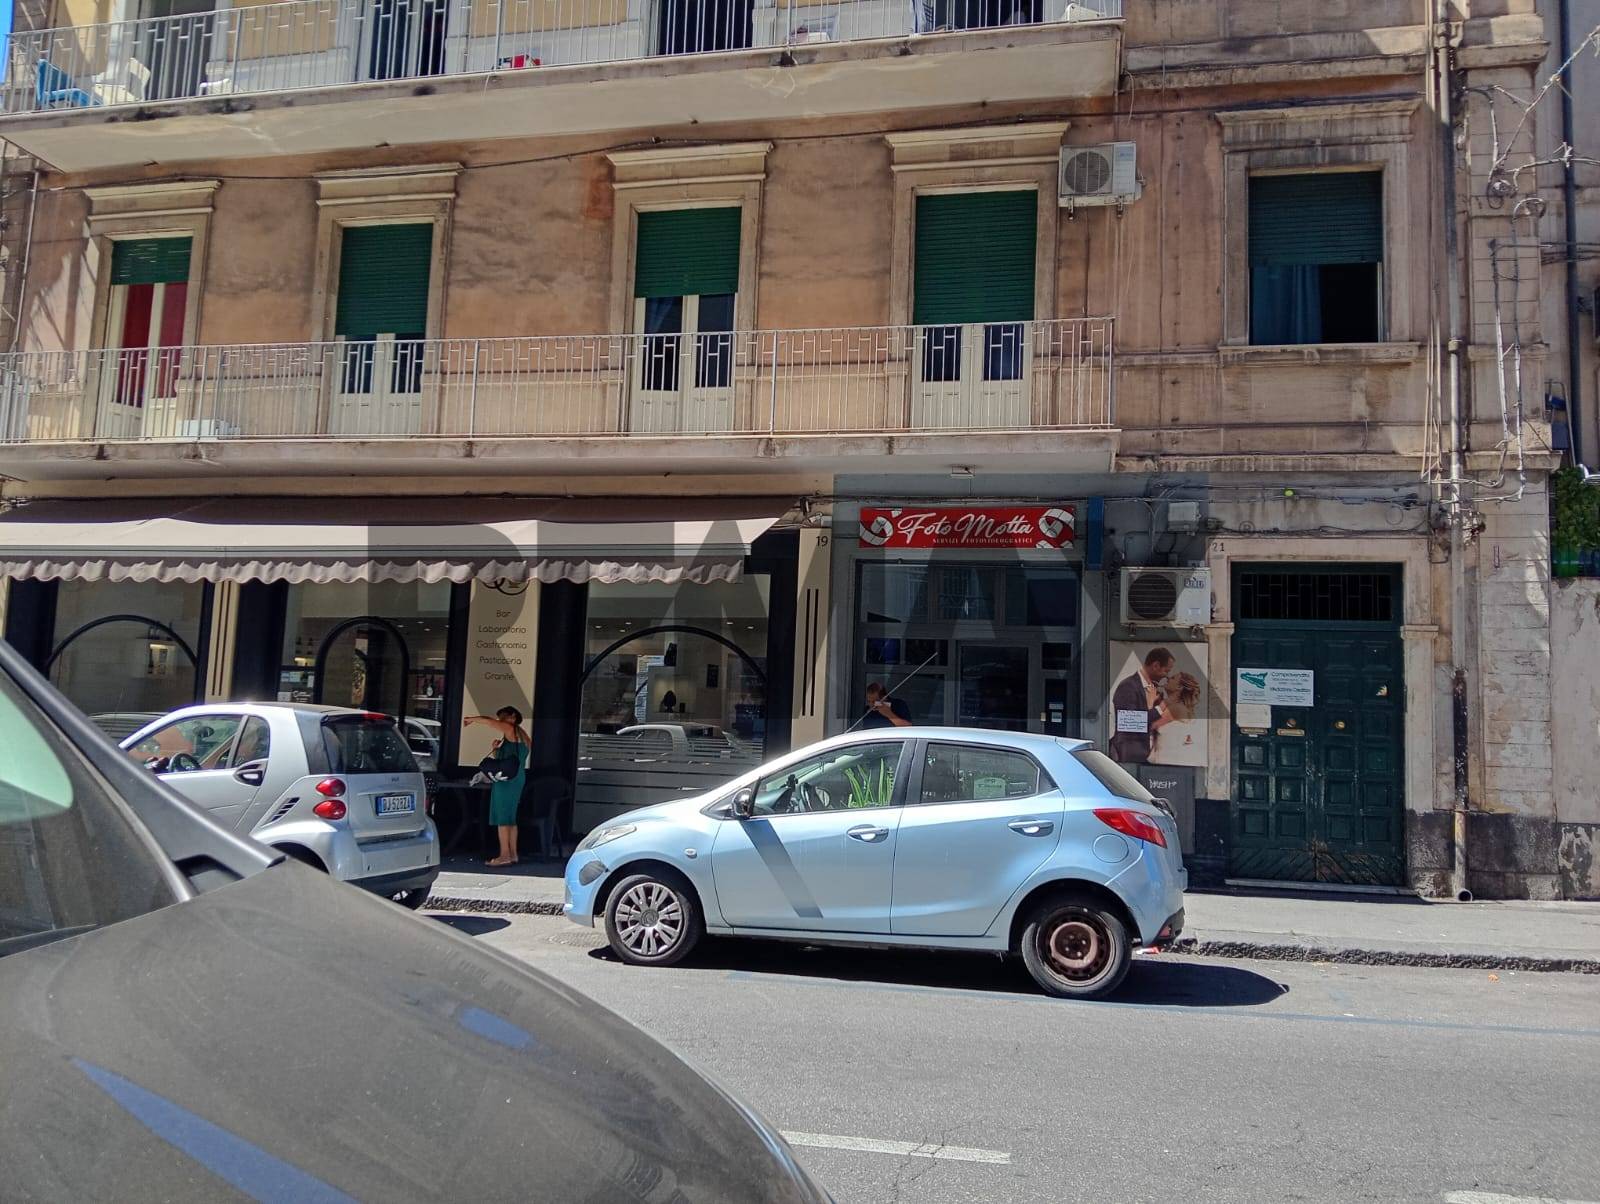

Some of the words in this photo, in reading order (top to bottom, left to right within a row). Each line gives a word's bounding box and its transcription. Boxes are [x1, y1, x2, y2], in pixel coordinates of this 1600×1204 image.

[897, 512, 951, 544] Foto
[954, 513, 1034, 544] Motta
[816, 535, 828, 546] 19
[1212, 542, 1225, 552] 21
[496, 609, 512, 618] Bar
[478, 625, 527, 634] Laboratorio
[476, 641, 527, 649] Gastronomia
[480, 656, 522, 665] Pasticceria
